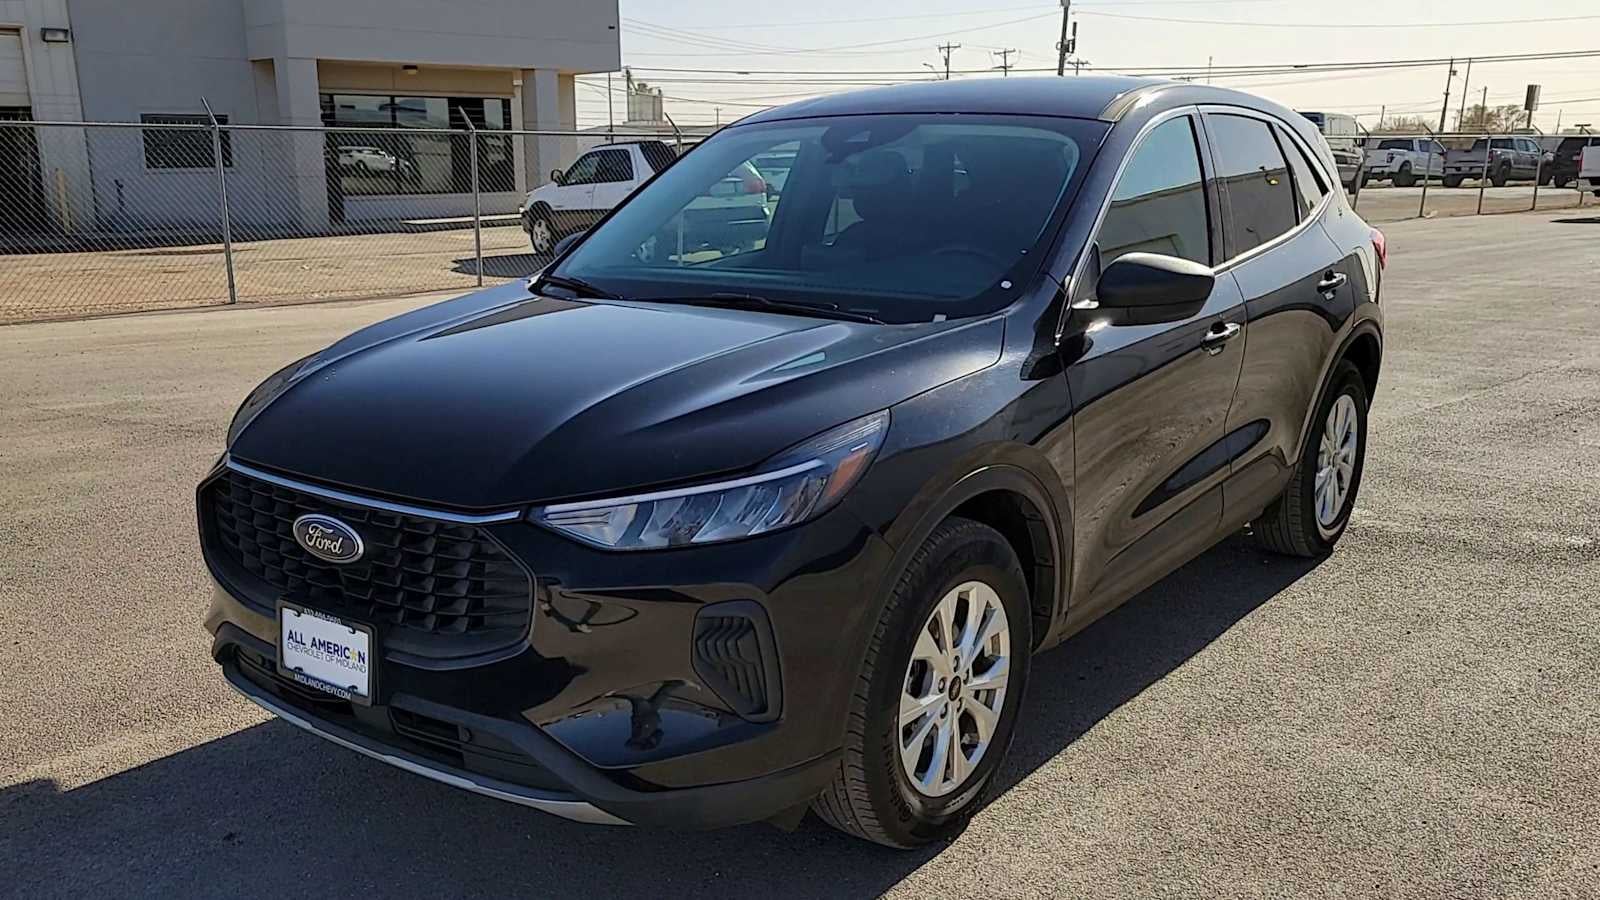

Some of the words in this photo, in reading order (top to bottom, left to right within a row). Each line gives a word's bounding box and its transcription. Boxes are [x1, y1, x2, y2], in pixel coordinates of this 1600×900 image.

[305, 523, 343, 554] Ford
[287, 629, 306, 646] ALL
[286, 641, 324, 661] CHEVROLET
[325, 654, 335, 663] OF
[335, 656, 367, 674] MIDLAND
